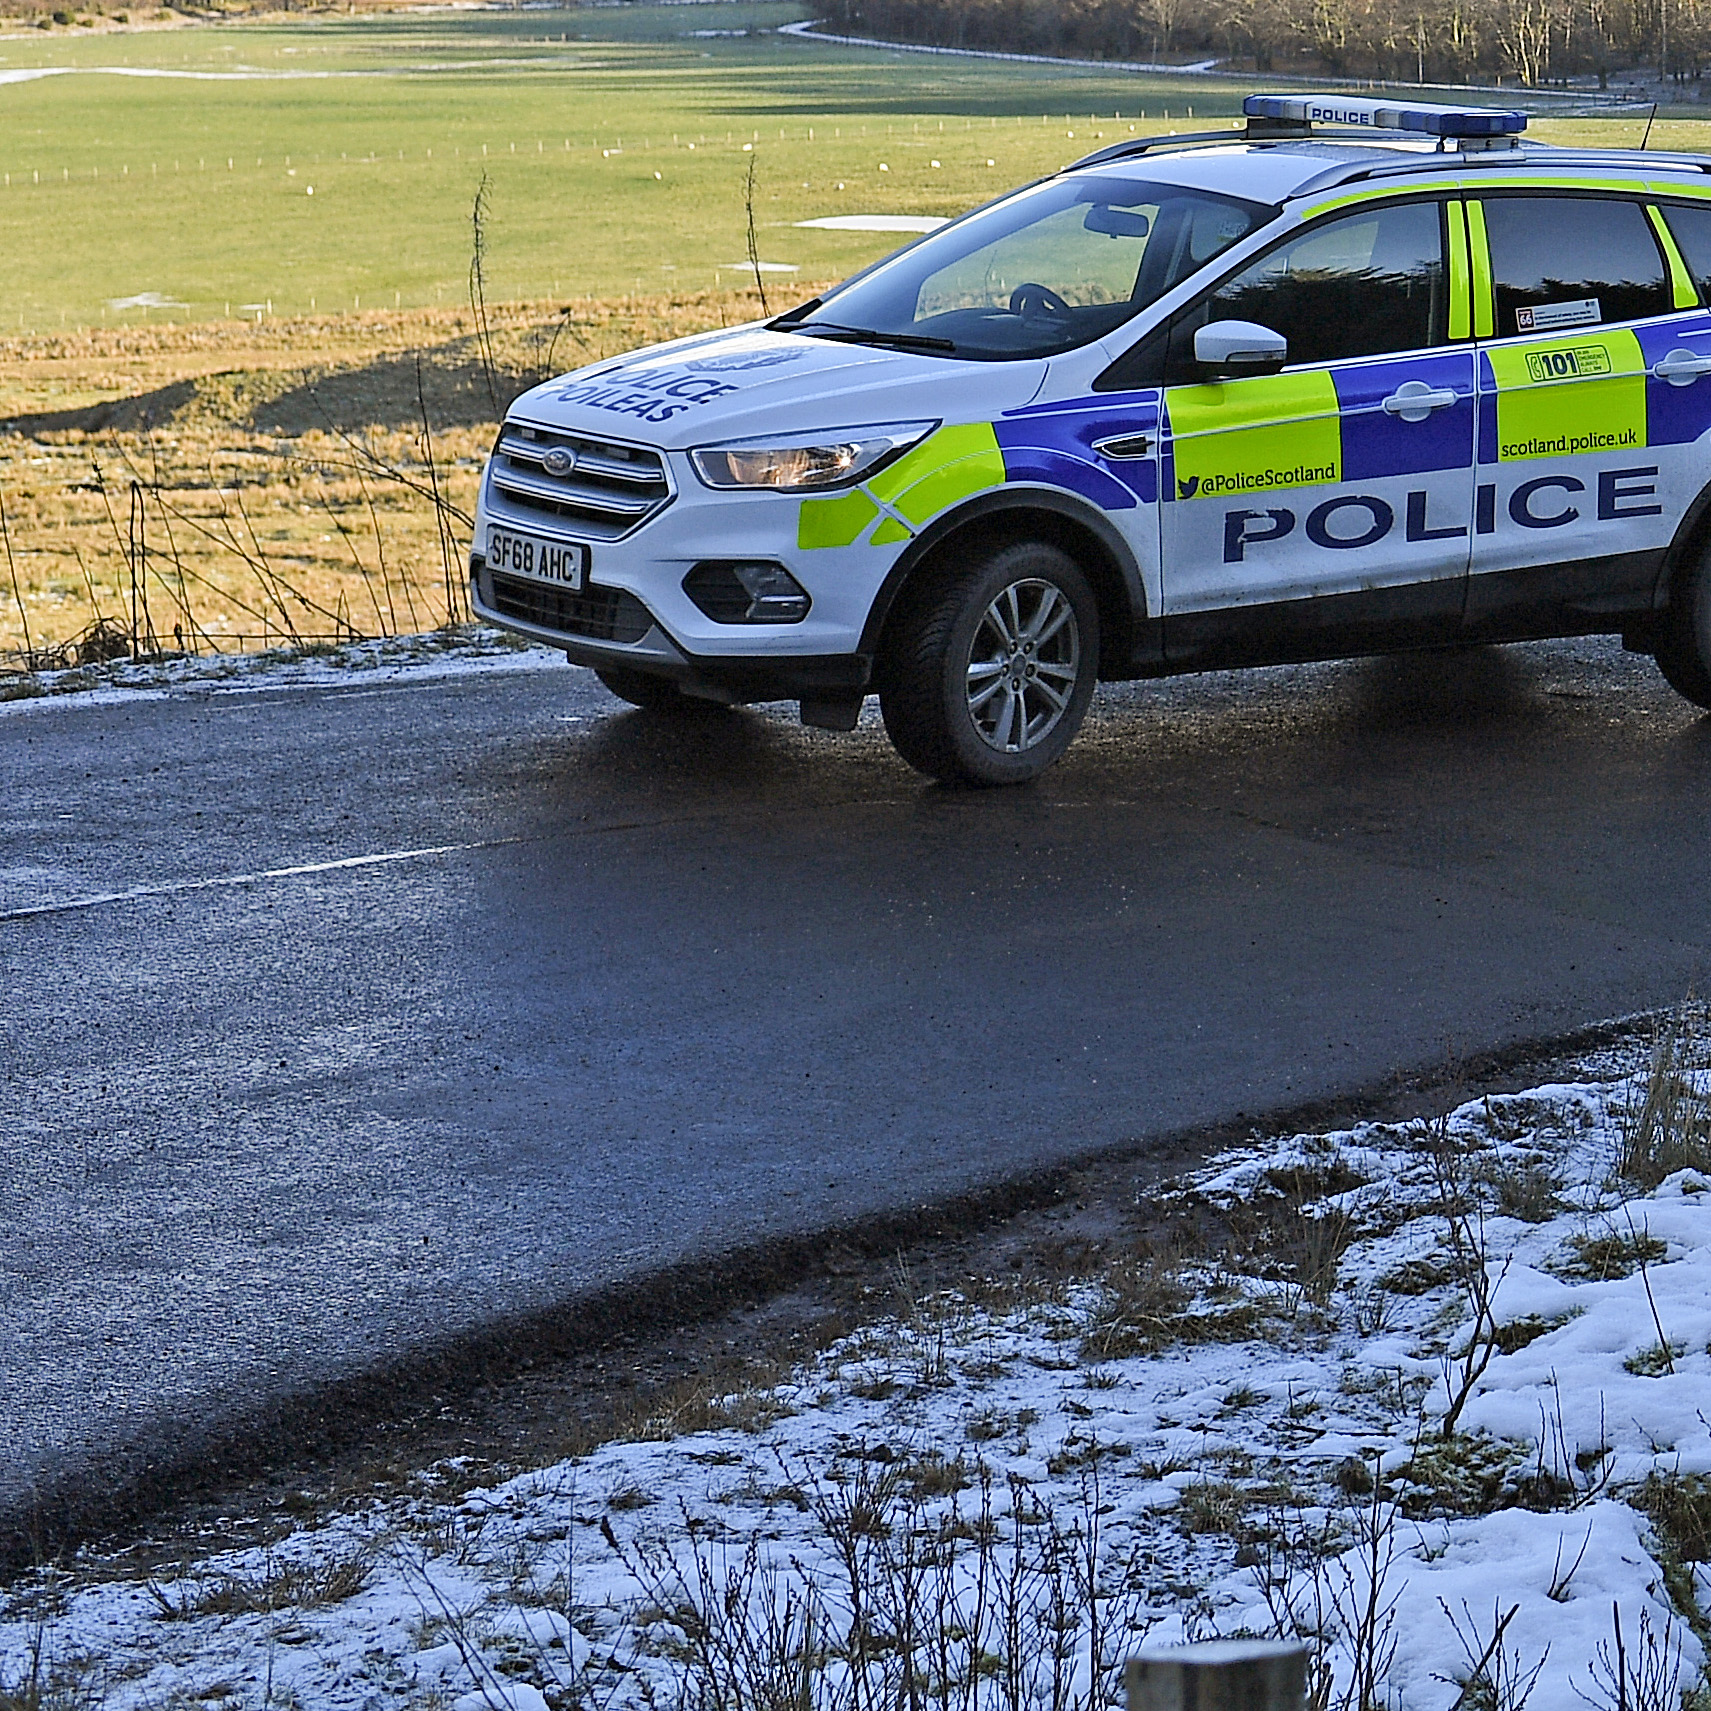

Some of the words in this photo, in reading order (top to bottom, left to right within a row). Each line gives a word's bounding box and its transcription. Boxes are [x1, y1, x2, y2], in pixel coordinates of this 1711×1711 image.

[1312, 108, 1369, 124] POLICE
[1542, 352, 1578, 376] 101
[1502, 428, 1637, 457] scotland.police.uk
[1201, 462, 1336, 495] @PoliceScotland
[1223, 465, 1662, 563] POLICE
[492, 534, 534, 573] SF68
[538, 545, 574, 582] AHC
